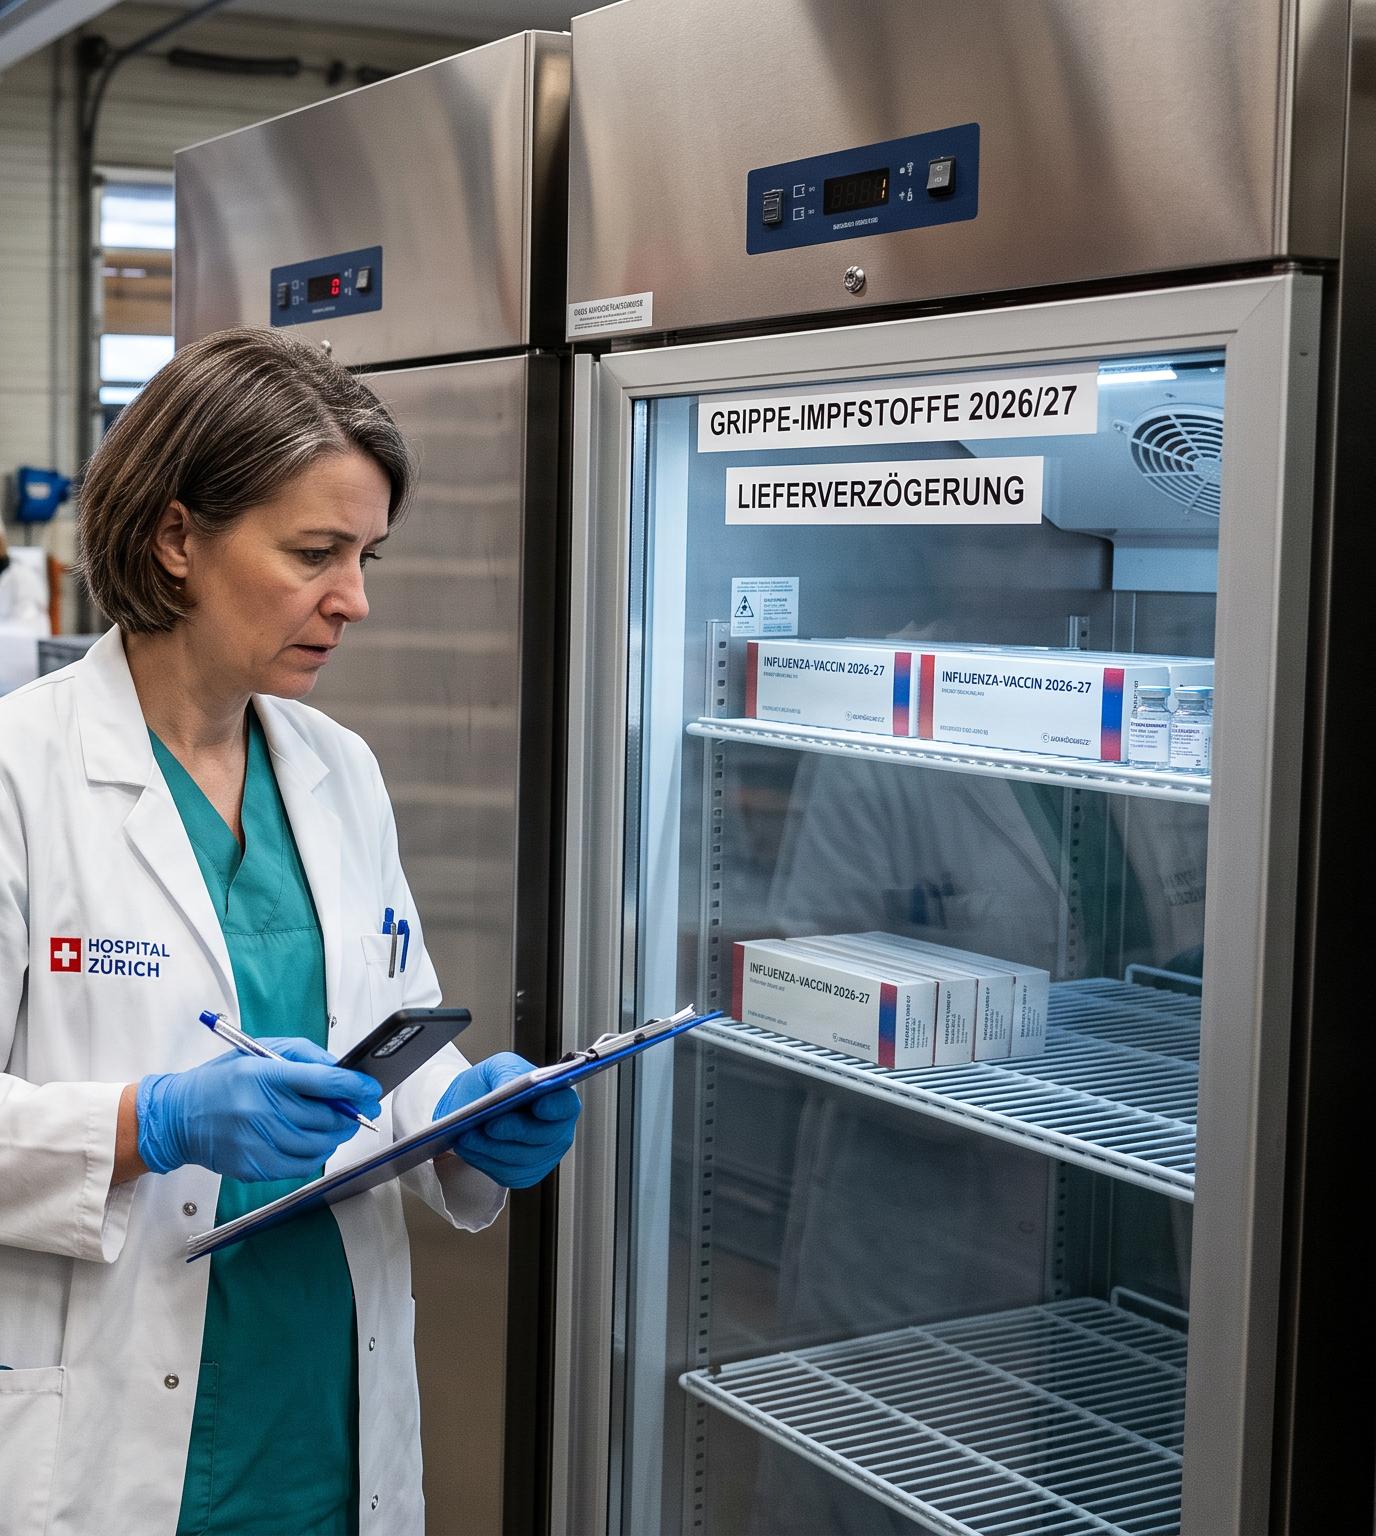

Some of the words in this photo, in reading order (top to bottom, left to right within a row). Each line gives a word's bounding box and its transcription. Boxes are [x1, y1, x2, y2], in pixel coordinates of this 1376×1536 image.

[710, 393, 960, 436] GRIPPE-IMPFSTOFFE
[968, 385, 1078, 421] 2026/27
[738, 472, 1024, 509] LIEFERVERZÖGERUNG
[763, 655, 846, 674] INFLUENZA-VACCIN
[847, 662, 885, 676] 2026-27
[941, 670, 1043, 690] INFLUENZA-VACCIN
[1044, 678, 1092, 694] 2026-27
[88, 938, 170, 958] HOSPITAL
[87, 954, 160, 978] ZÜRICH
[749, 961, 833, 995] INFLUENZA-VACCIN
[833, 985, 870, 1005] 2026-27
